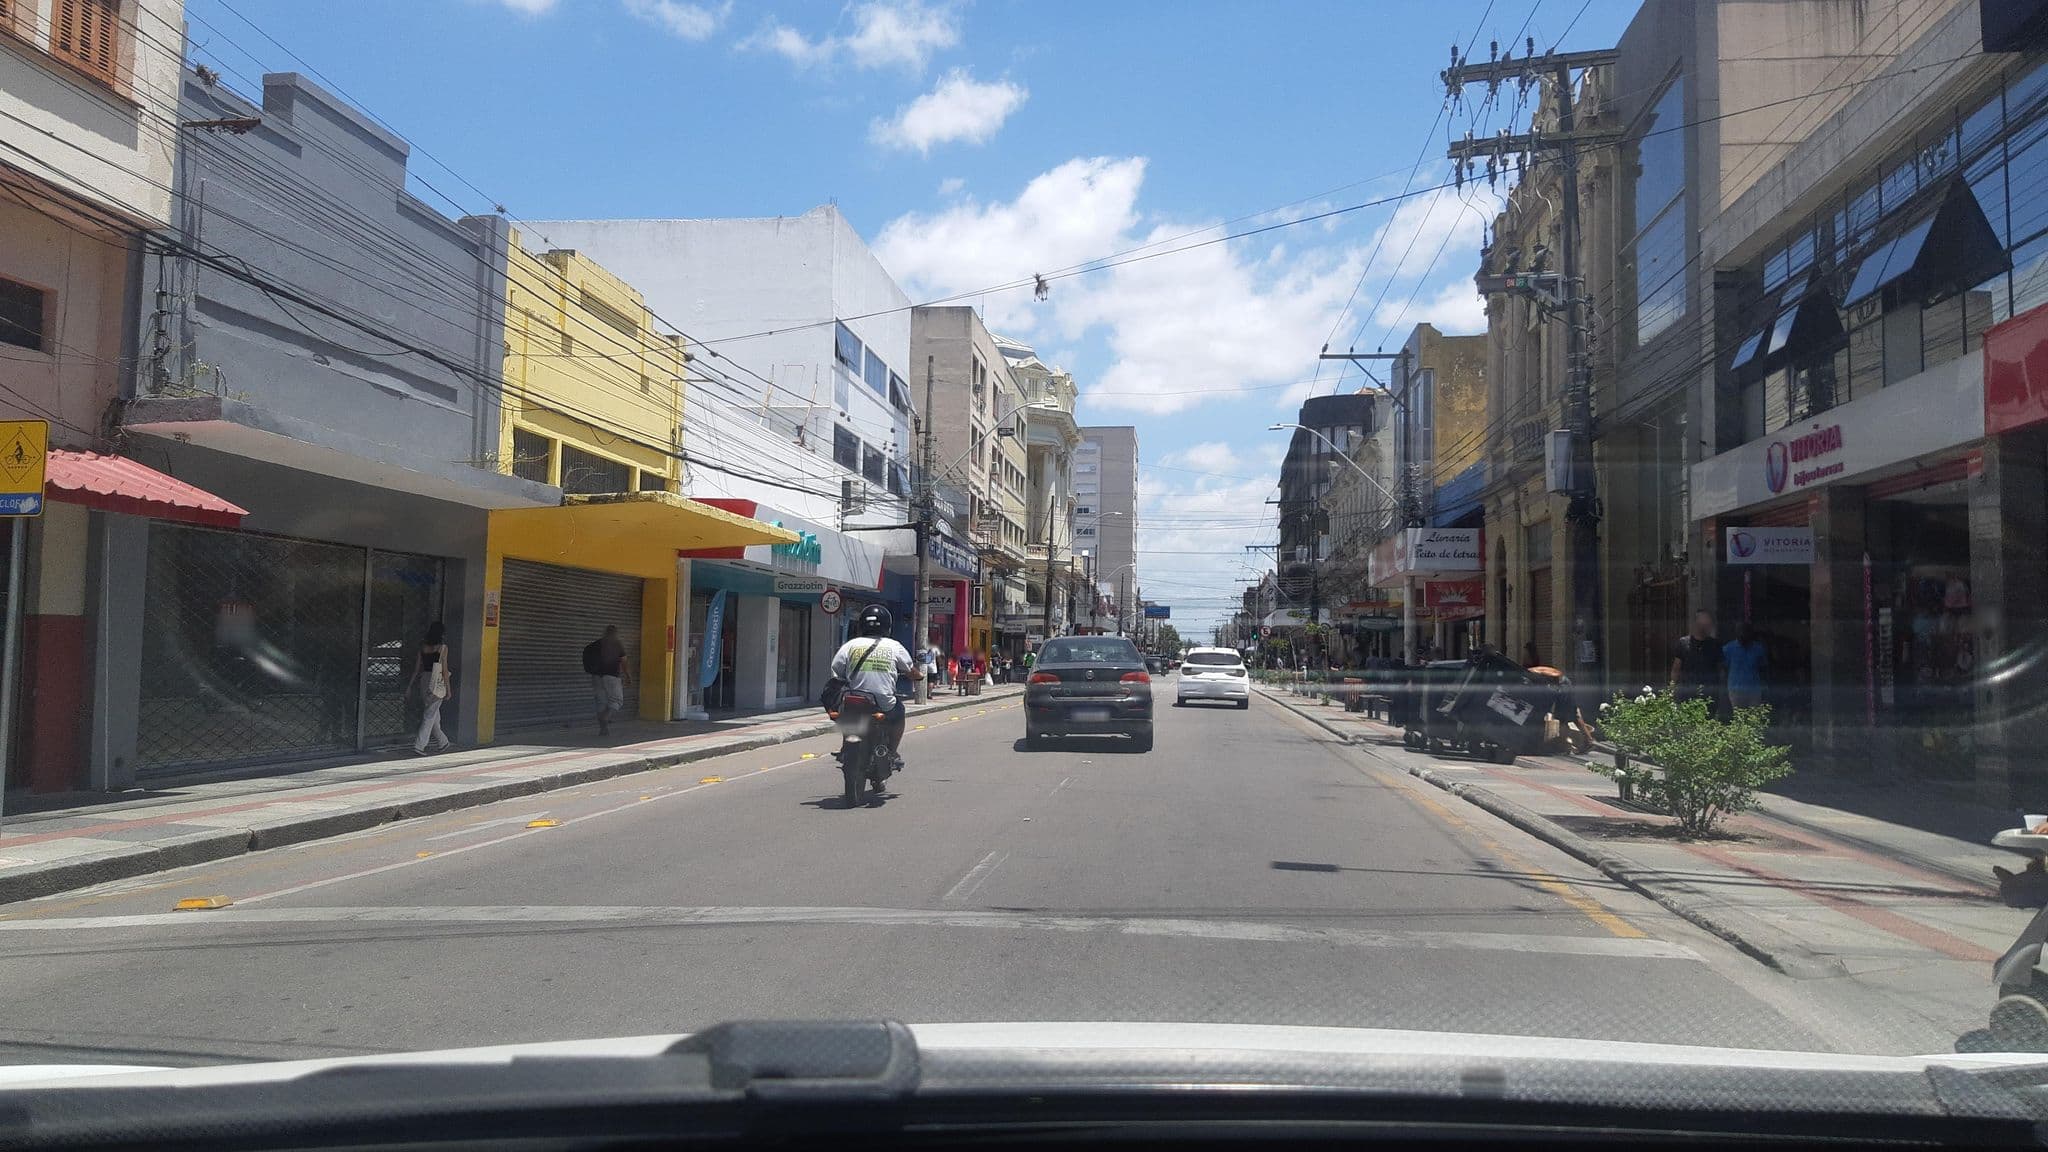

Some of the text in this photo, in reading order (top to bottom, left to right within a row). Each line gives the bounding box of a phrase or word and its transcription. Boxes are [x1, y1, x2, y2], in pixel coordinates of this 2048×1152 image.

[1439, 550, 1450, 558] de
[777, 580, 823, 590] Grazziotin
[707, 606, 719, 668] Grazziotin
